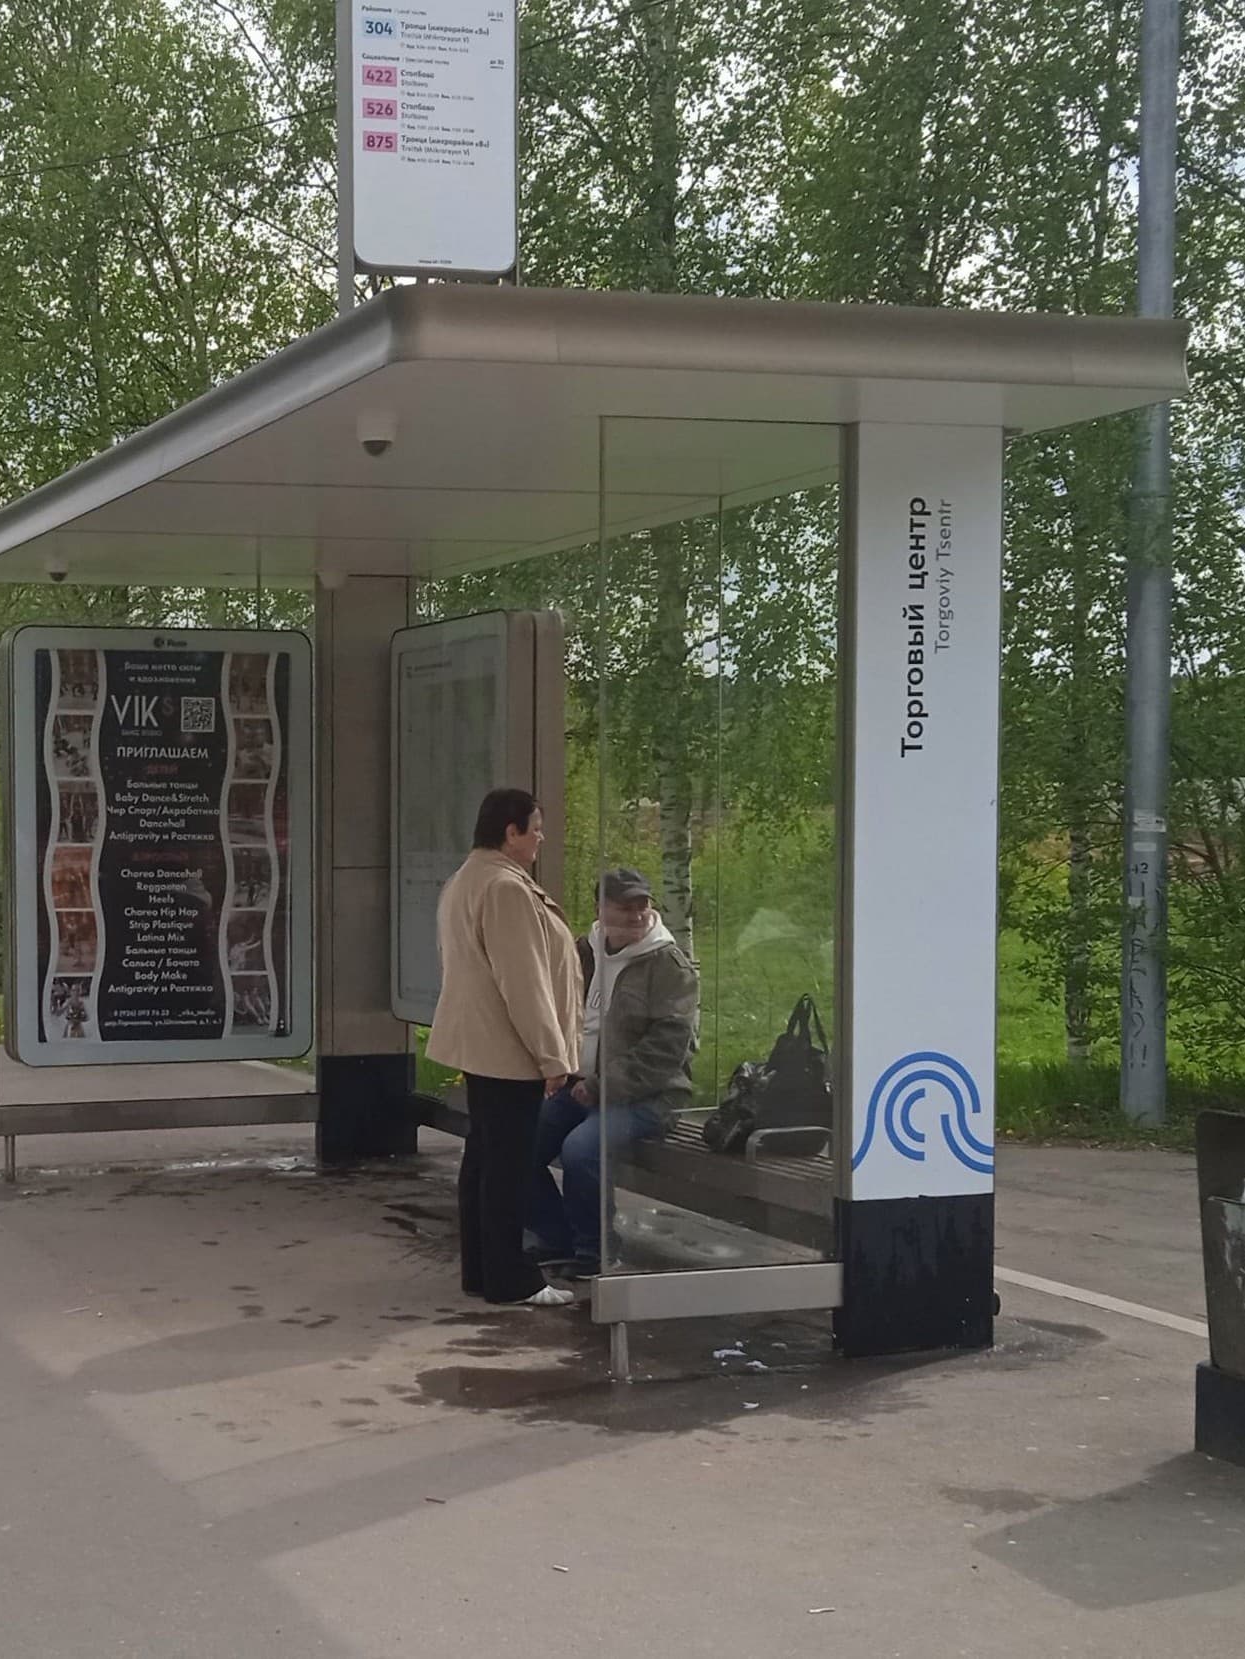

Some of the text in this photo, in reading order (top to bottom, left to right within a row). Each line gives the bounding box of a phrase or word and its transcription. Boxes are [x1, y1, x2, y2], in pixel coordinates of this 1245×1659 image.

[365, 21, 393, 35] 304
[366, 70, 393, 83] 422
[367, 103, 393, 116] 526
[366, 135, 393, 149] 875
[934, 499, 954, 654] Torgoviy Tsentr
[900, 497, 932, 758] Торговый центр
[117, 746, 208, 759] ПРИГЛАШАЕМ
[115, 792, 139, 804] Baby
[107, 806, 126, 816] Чир
[139, 818, 185, 828] Dancehall
[109, 831, 160, 843] Antigravity
[120, 868, 203, 878] Choreo Dancehall
[149, 894, 174, 904] Heels
[124, 907, 198, 918] Choreo Hip Hop
[129, 920, 194, 931] Strip Plastique
[137, 933, 185, 942] Latina Mix
[135, 970, 187, 982] Body Make
[108, 984, 159, 995] Antigravity
